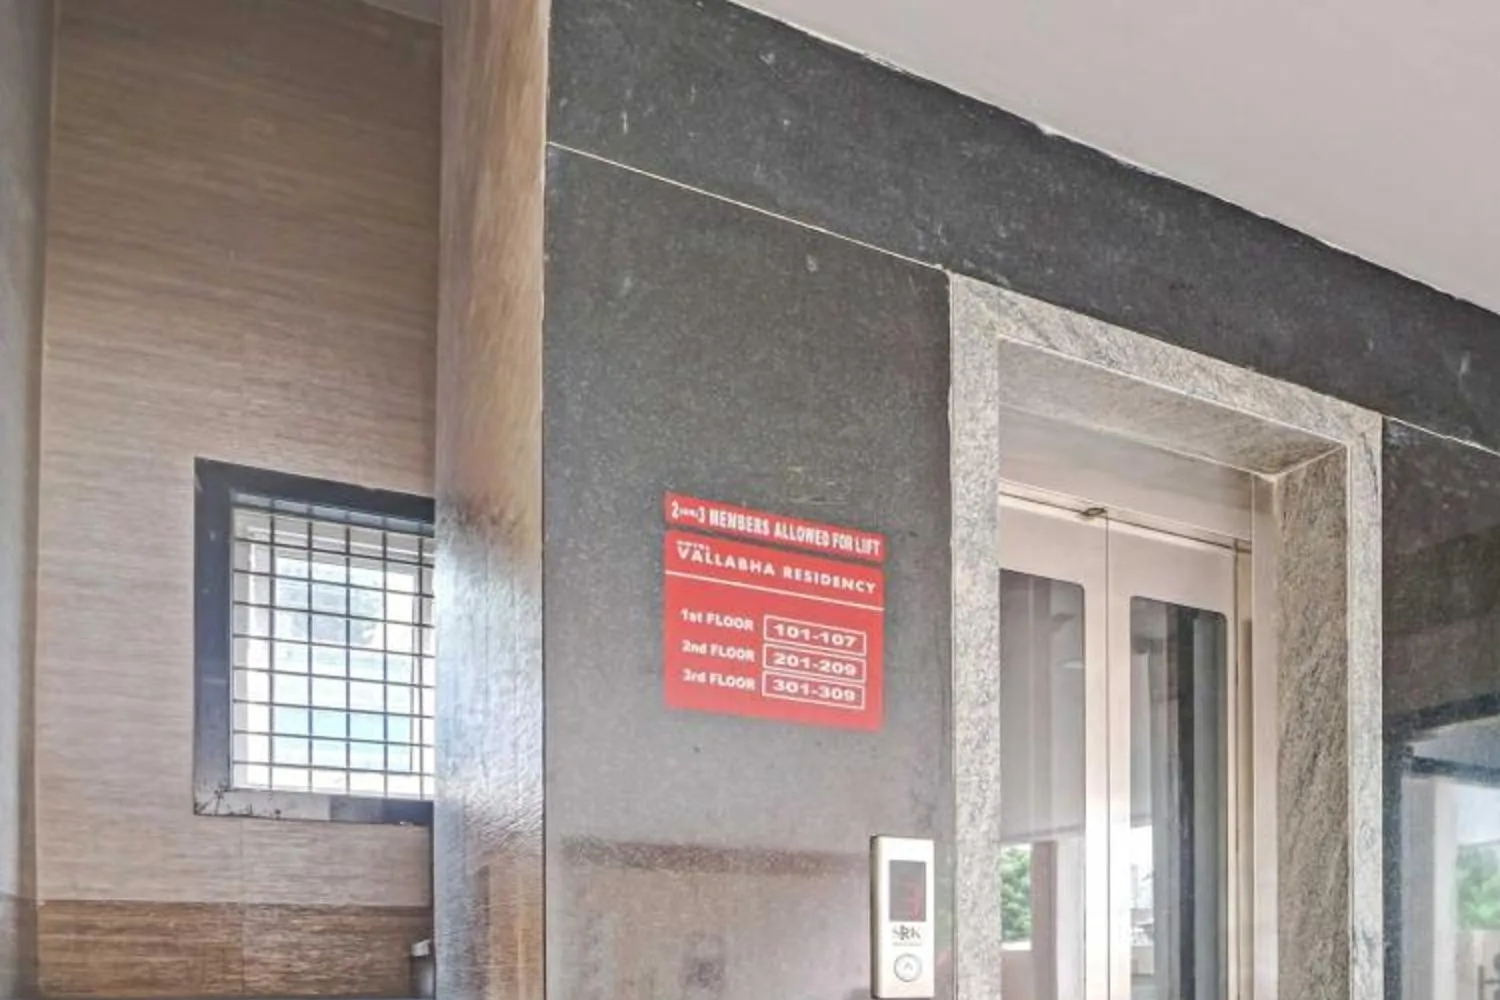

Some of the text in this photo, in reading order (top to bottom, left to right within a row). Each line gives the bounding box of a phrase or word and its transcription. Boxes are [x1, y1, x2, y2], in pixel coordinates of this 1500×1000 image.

[774, 521, 830, 547] ALLOWED
[832, 533, 853, 552] FOR
[855, 536, 881, 556] LIFT
[677, 545, 877, 594] VALLABHA RESIDENCY
[706, 612, 754, 632] FLOOR
[773, 623, 858, 648] 101-107
[681, 639, 755, 662] 2nd FLOOR
[772, 652, 857, 676] 201-209
[682, 668, 755, 690] 3rd FLOOR
[772, 679, 856, 702] 301-309
